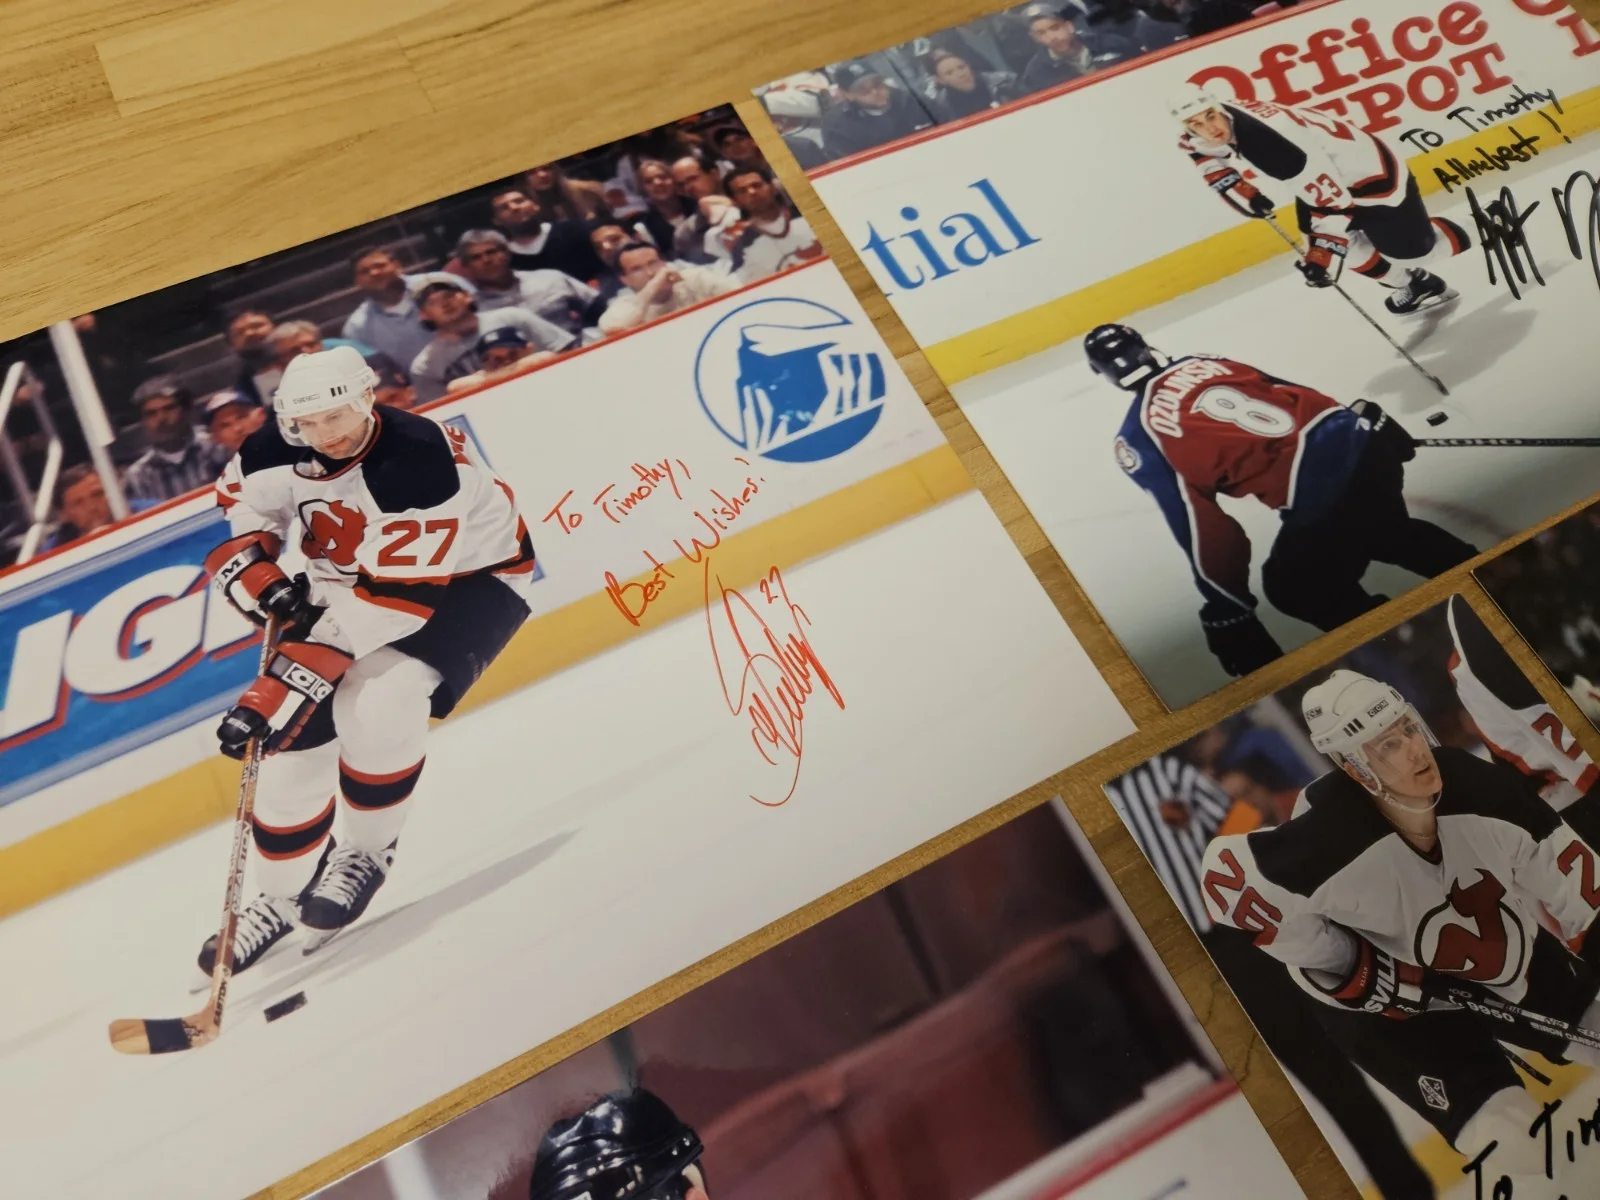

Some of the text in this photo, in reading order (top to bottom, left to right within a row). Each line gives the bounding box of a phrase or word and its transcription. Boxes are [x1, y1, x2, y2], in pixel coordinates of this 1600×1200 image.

[1312, 43, 1513, 133] POT
[1399, 84, 1564, 153] To Timothy
[1304, 173, 1342, 208] 23
[1189, 385, 1296, 438] 8
[542, 490, 583, 534] To
[377, 518, 460, 568] 27
[605, 550, 675, 626] Best
[1202, 848, 1282, 947] 26
[1466, 1001, 1515, 1023] 9950
[1462, 1139, 1513, 1200] To
